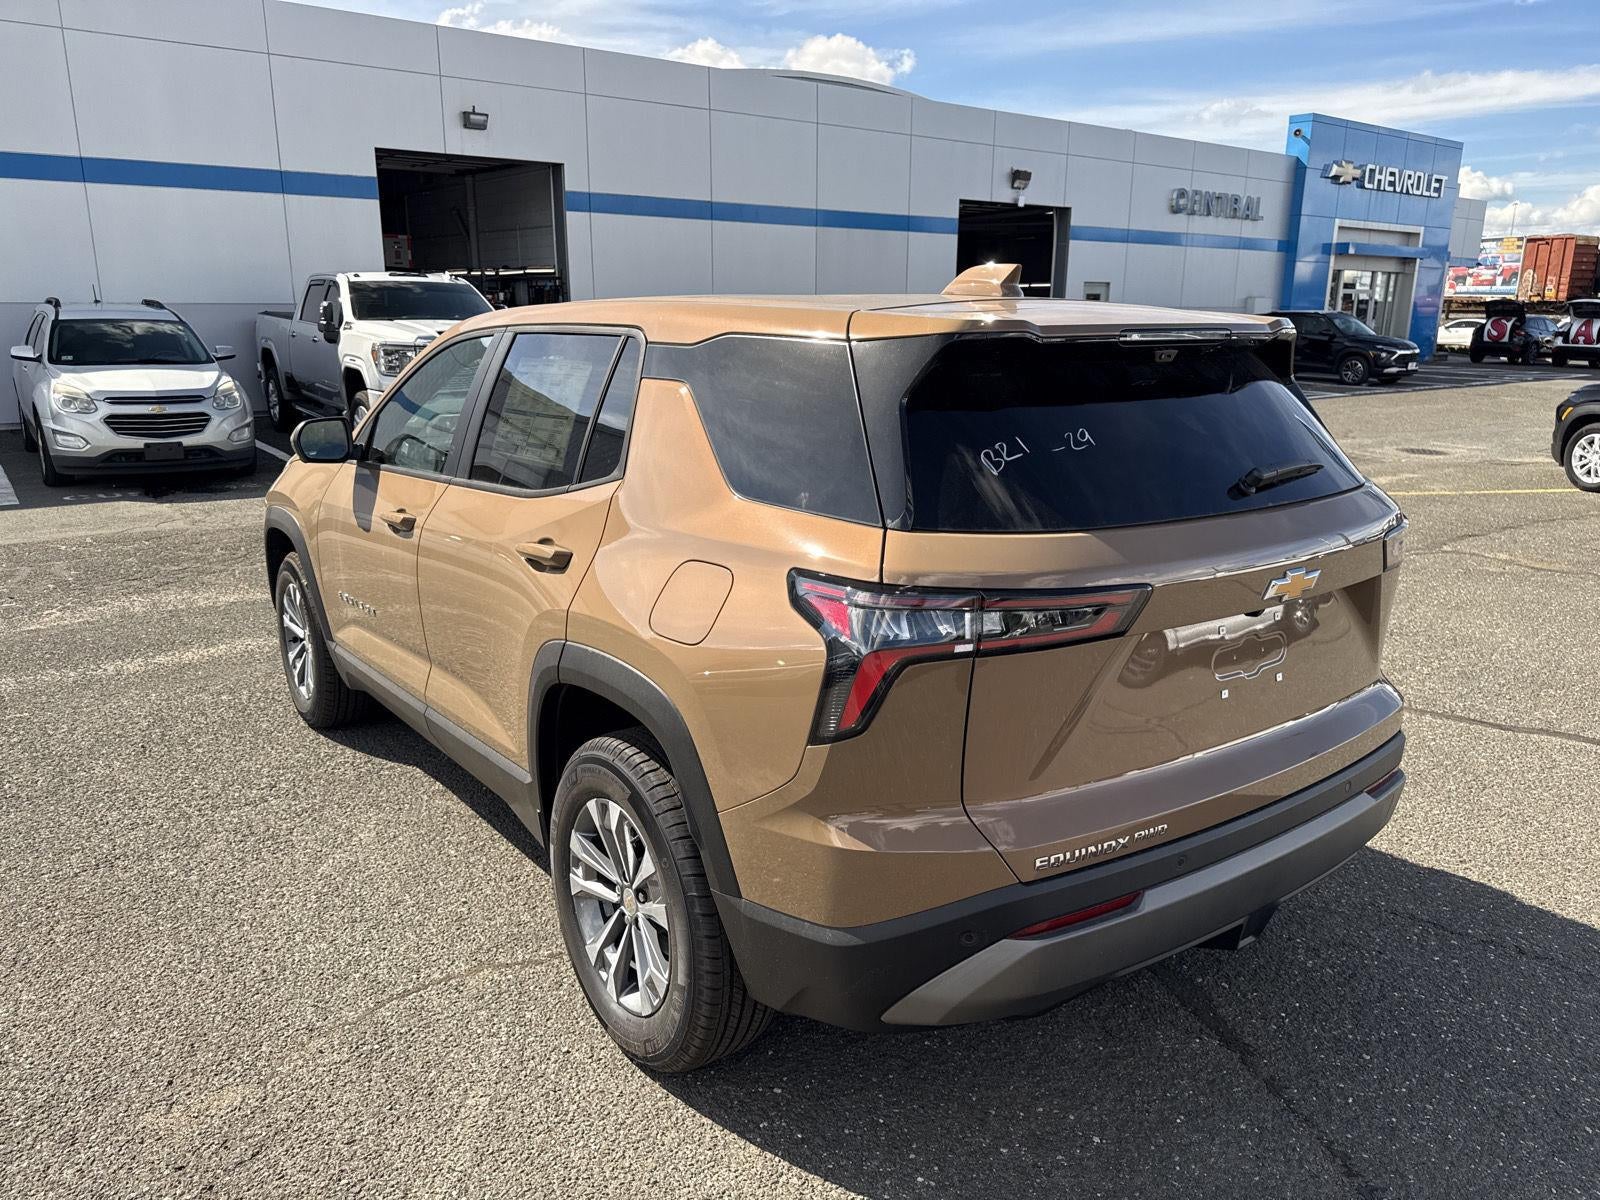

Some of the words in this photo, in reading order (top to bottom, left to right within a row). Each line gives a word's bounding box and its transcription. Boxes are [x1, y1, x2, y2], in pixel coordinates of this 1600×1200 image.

[1363, 163, 1448, 198] CHEVROLET
[1169, 187, 1265, 221] CENTRAL
[1570, 318, 1596, 345] A
[1034, 835, 1130, 871] EQUINOX
